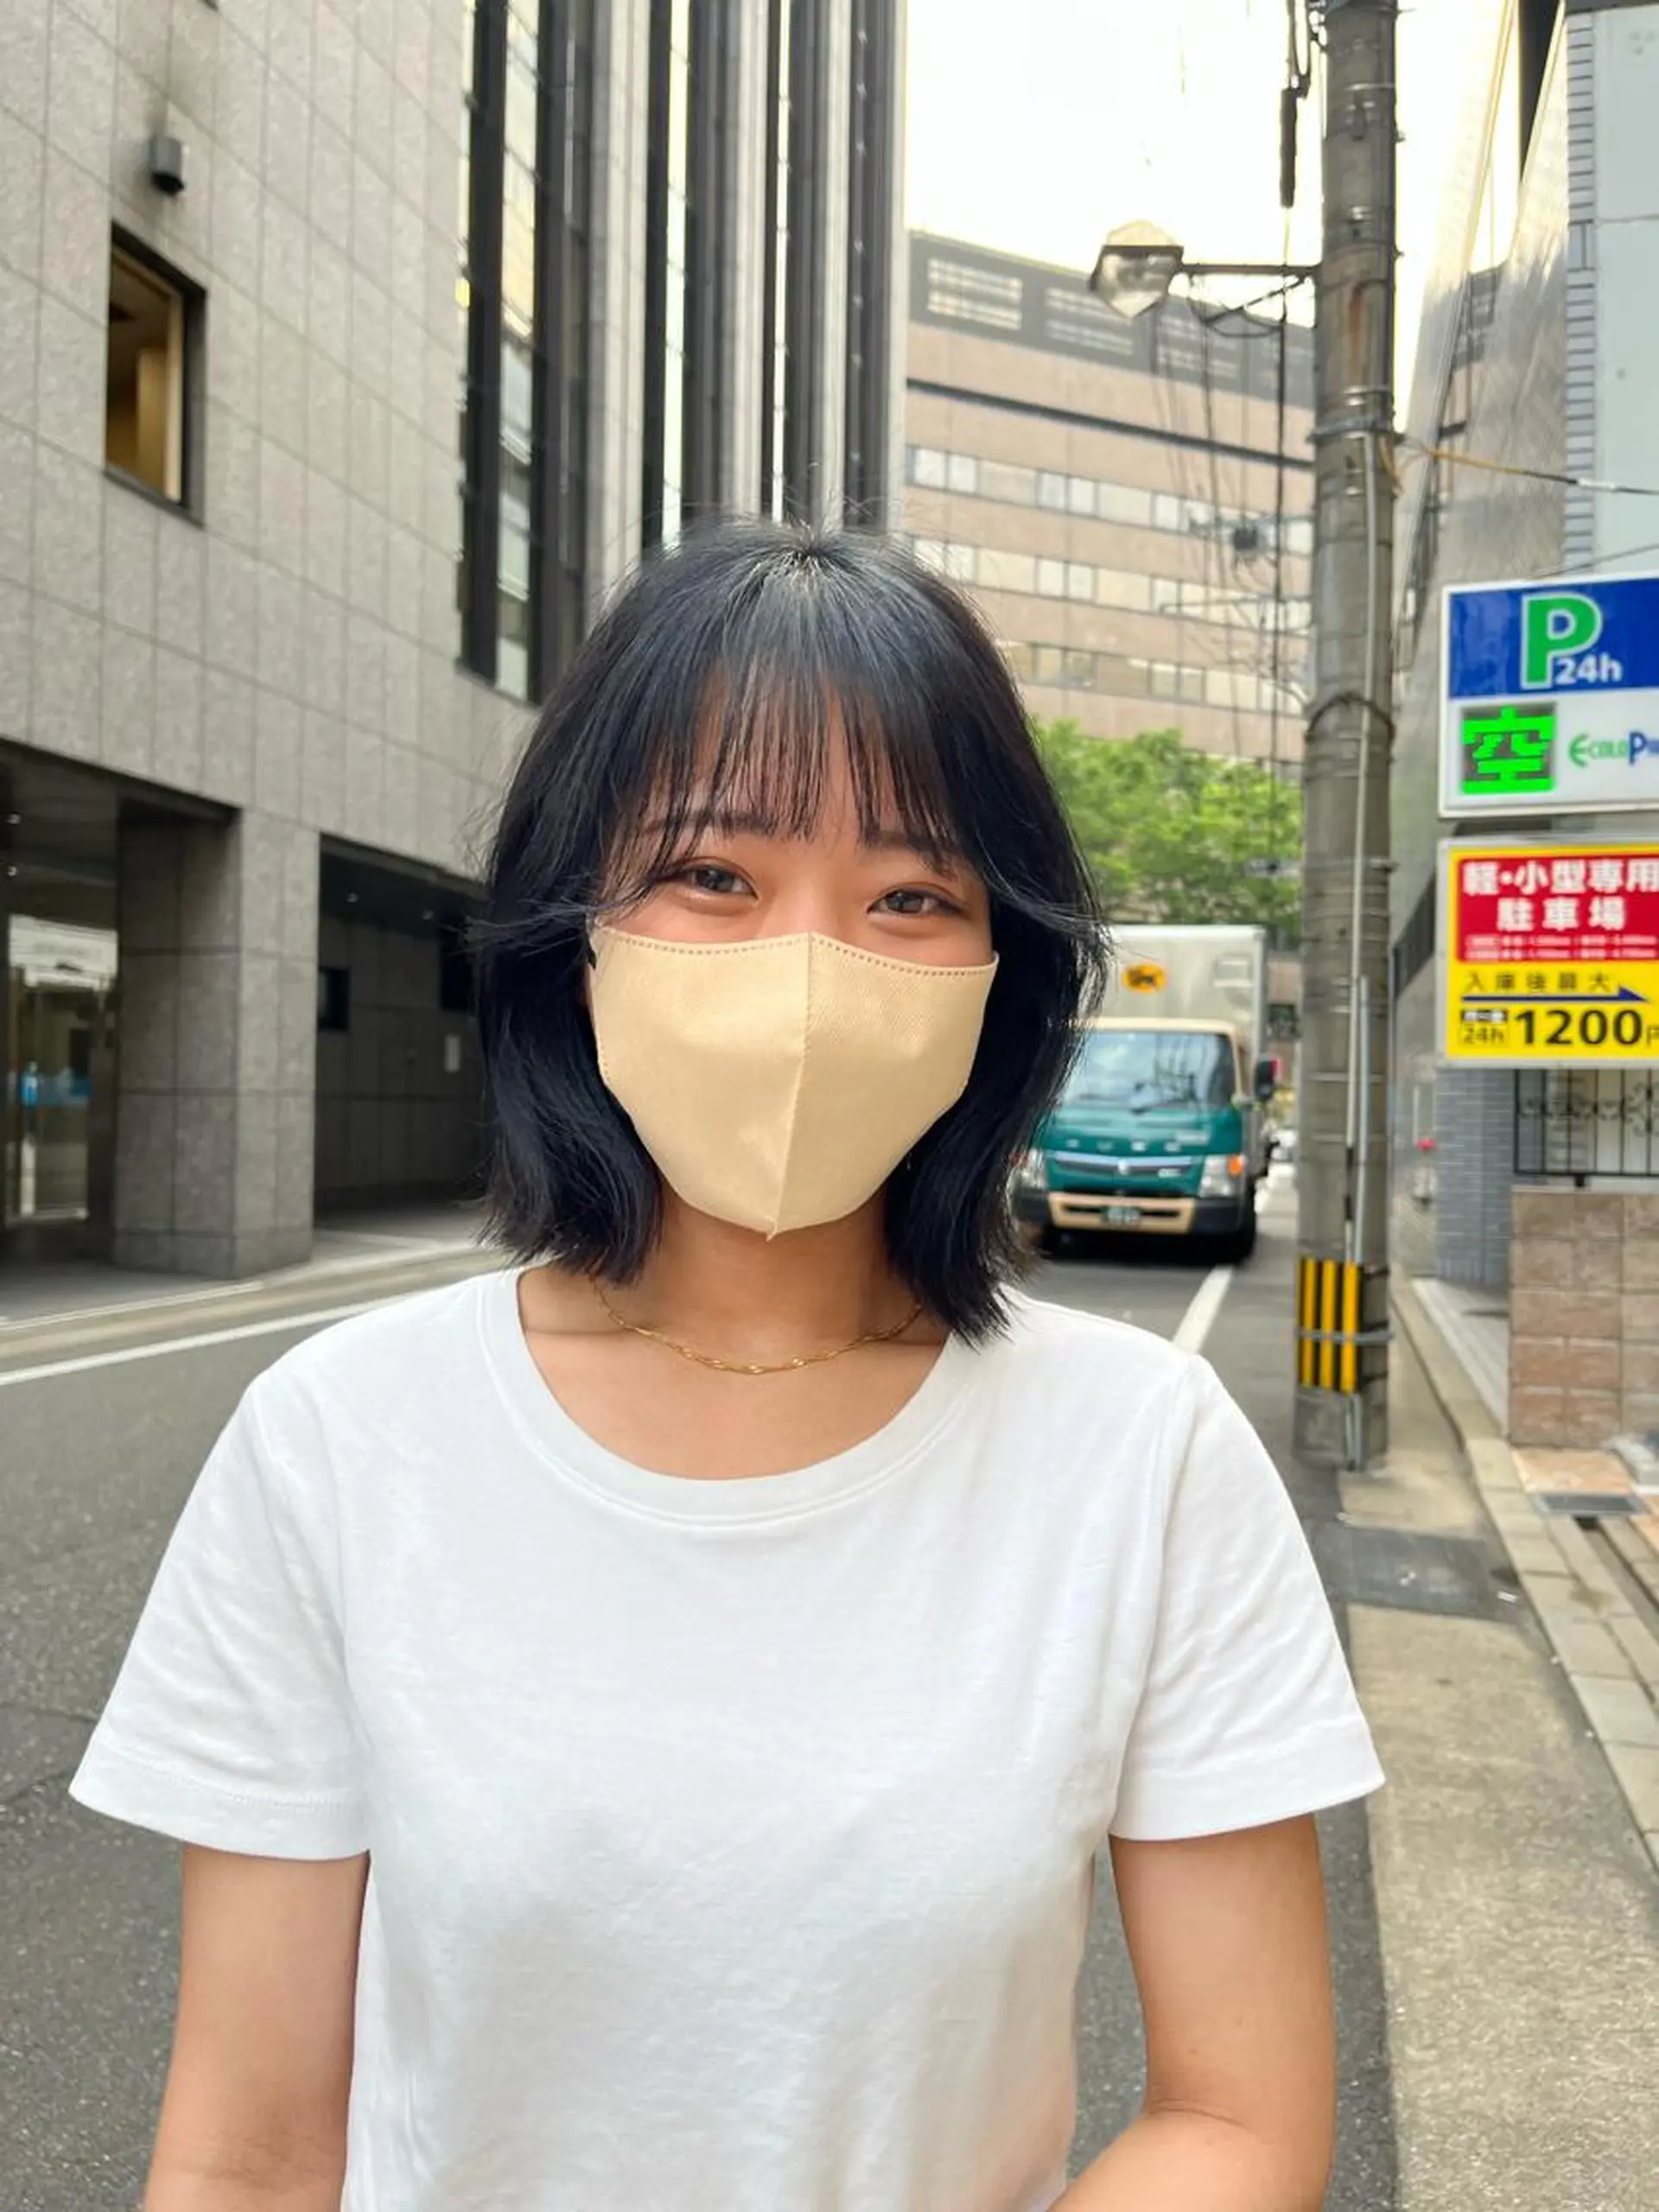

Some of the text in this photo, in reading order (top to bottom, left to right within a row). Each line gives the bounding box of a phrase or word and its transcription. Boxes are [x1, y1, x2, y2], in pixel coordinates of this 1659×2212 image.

[1520, 592, 1622, 690] P 24h
[1461, 706, 1556, 795] 空
[1496, 895, 1626, 931] 駐車場
